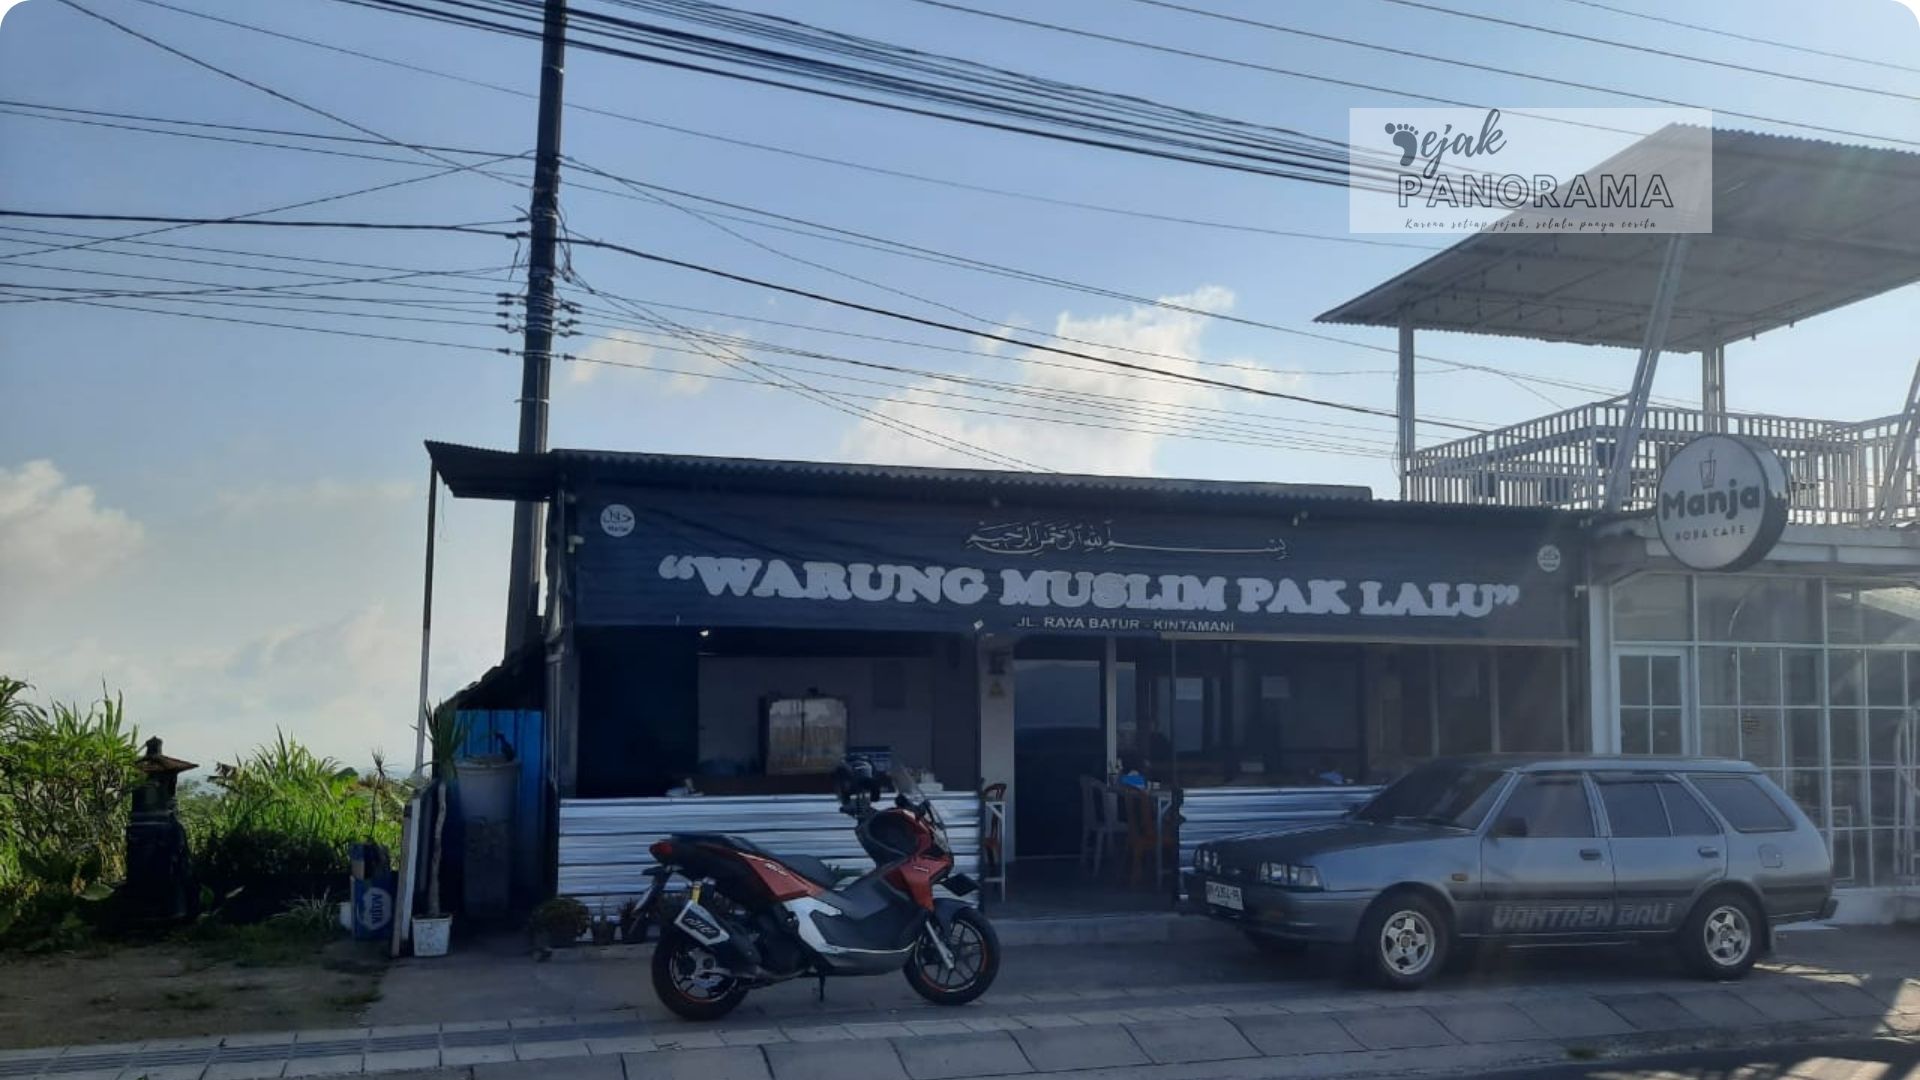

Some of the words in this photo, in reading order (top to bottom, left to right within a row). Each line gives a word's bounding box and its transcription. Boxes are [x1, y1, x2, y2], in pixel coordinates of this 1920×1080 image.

[1662, 479, 1760, 521] Manja
[1000, 570, 1226, 610] MUSLIM
[1237, 577, 1347, 613] PAK
[1044, 617, 1085, 630] RAYA
[1089, 618, 1141, 631] BATUR
[1153, 620, 1236, 633] KINTAMANI
